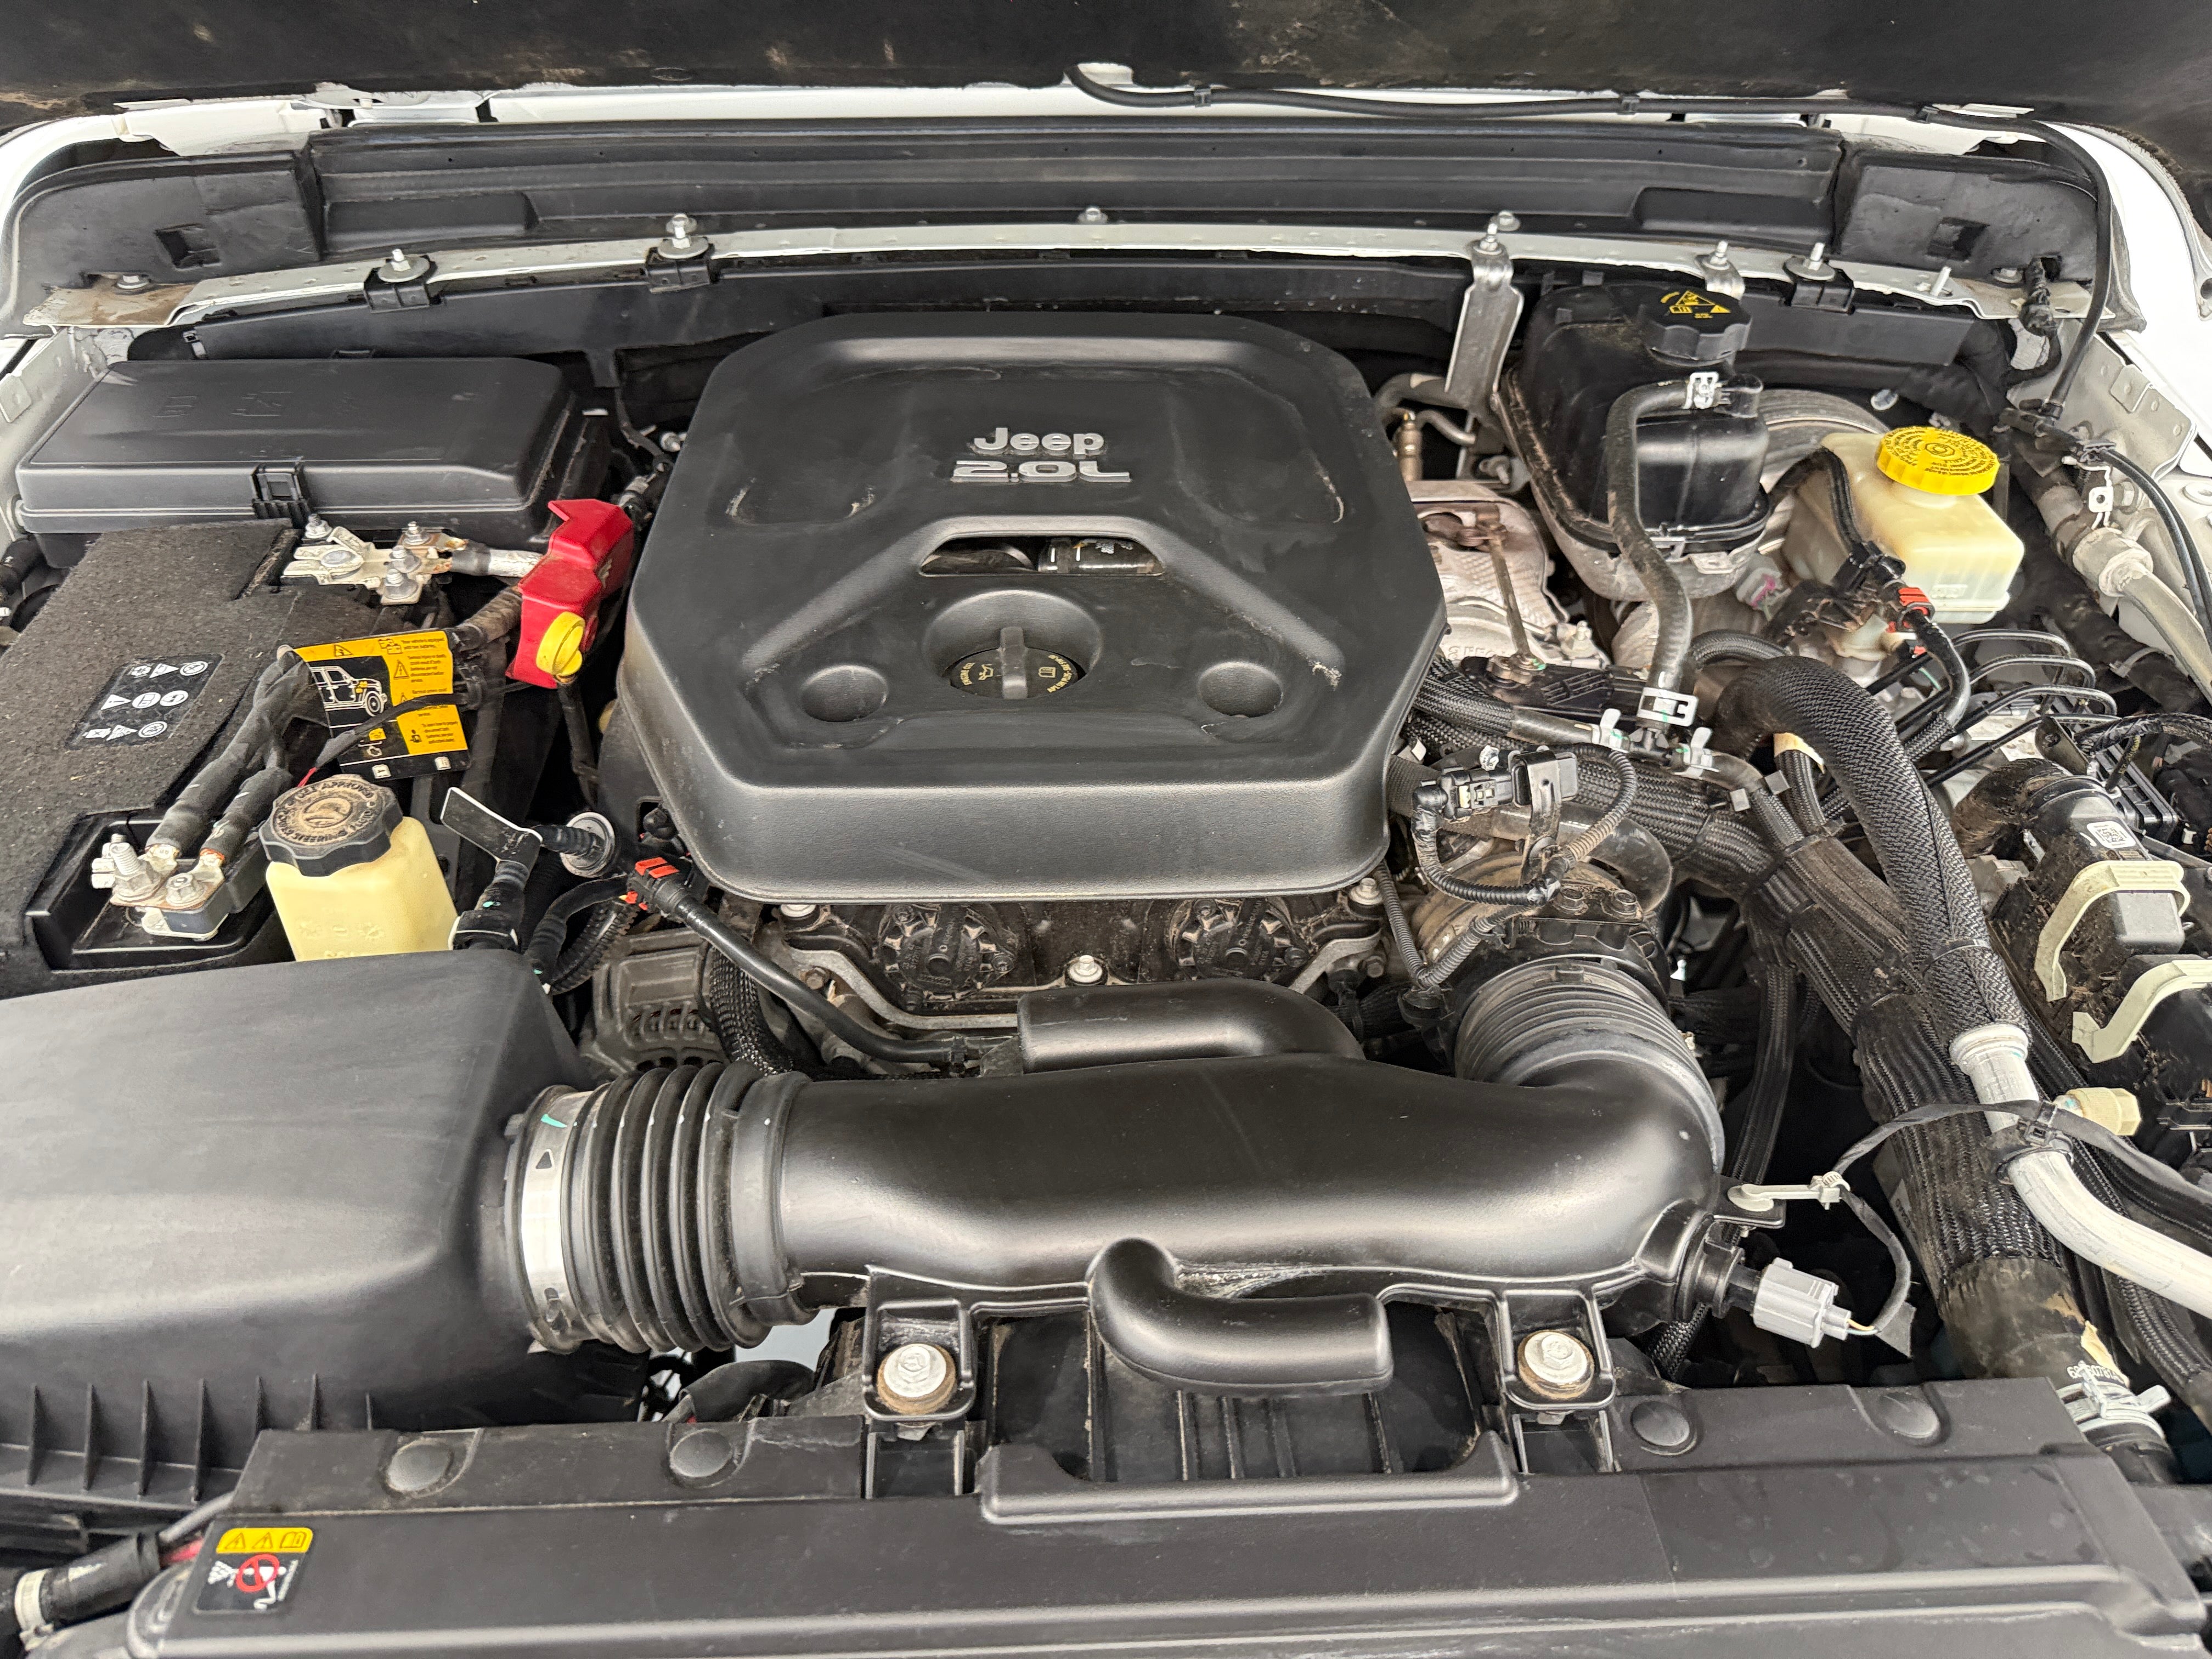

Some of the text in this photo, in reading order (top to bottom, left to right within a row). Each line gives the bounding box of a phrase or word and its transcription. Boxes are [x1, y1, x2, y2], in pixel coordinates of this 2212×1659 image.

[972, 427, 1104, 459] Jeep
[951, 460, 1131, 483] 2.0L
[320, 781, 374, 798] APPROVED
